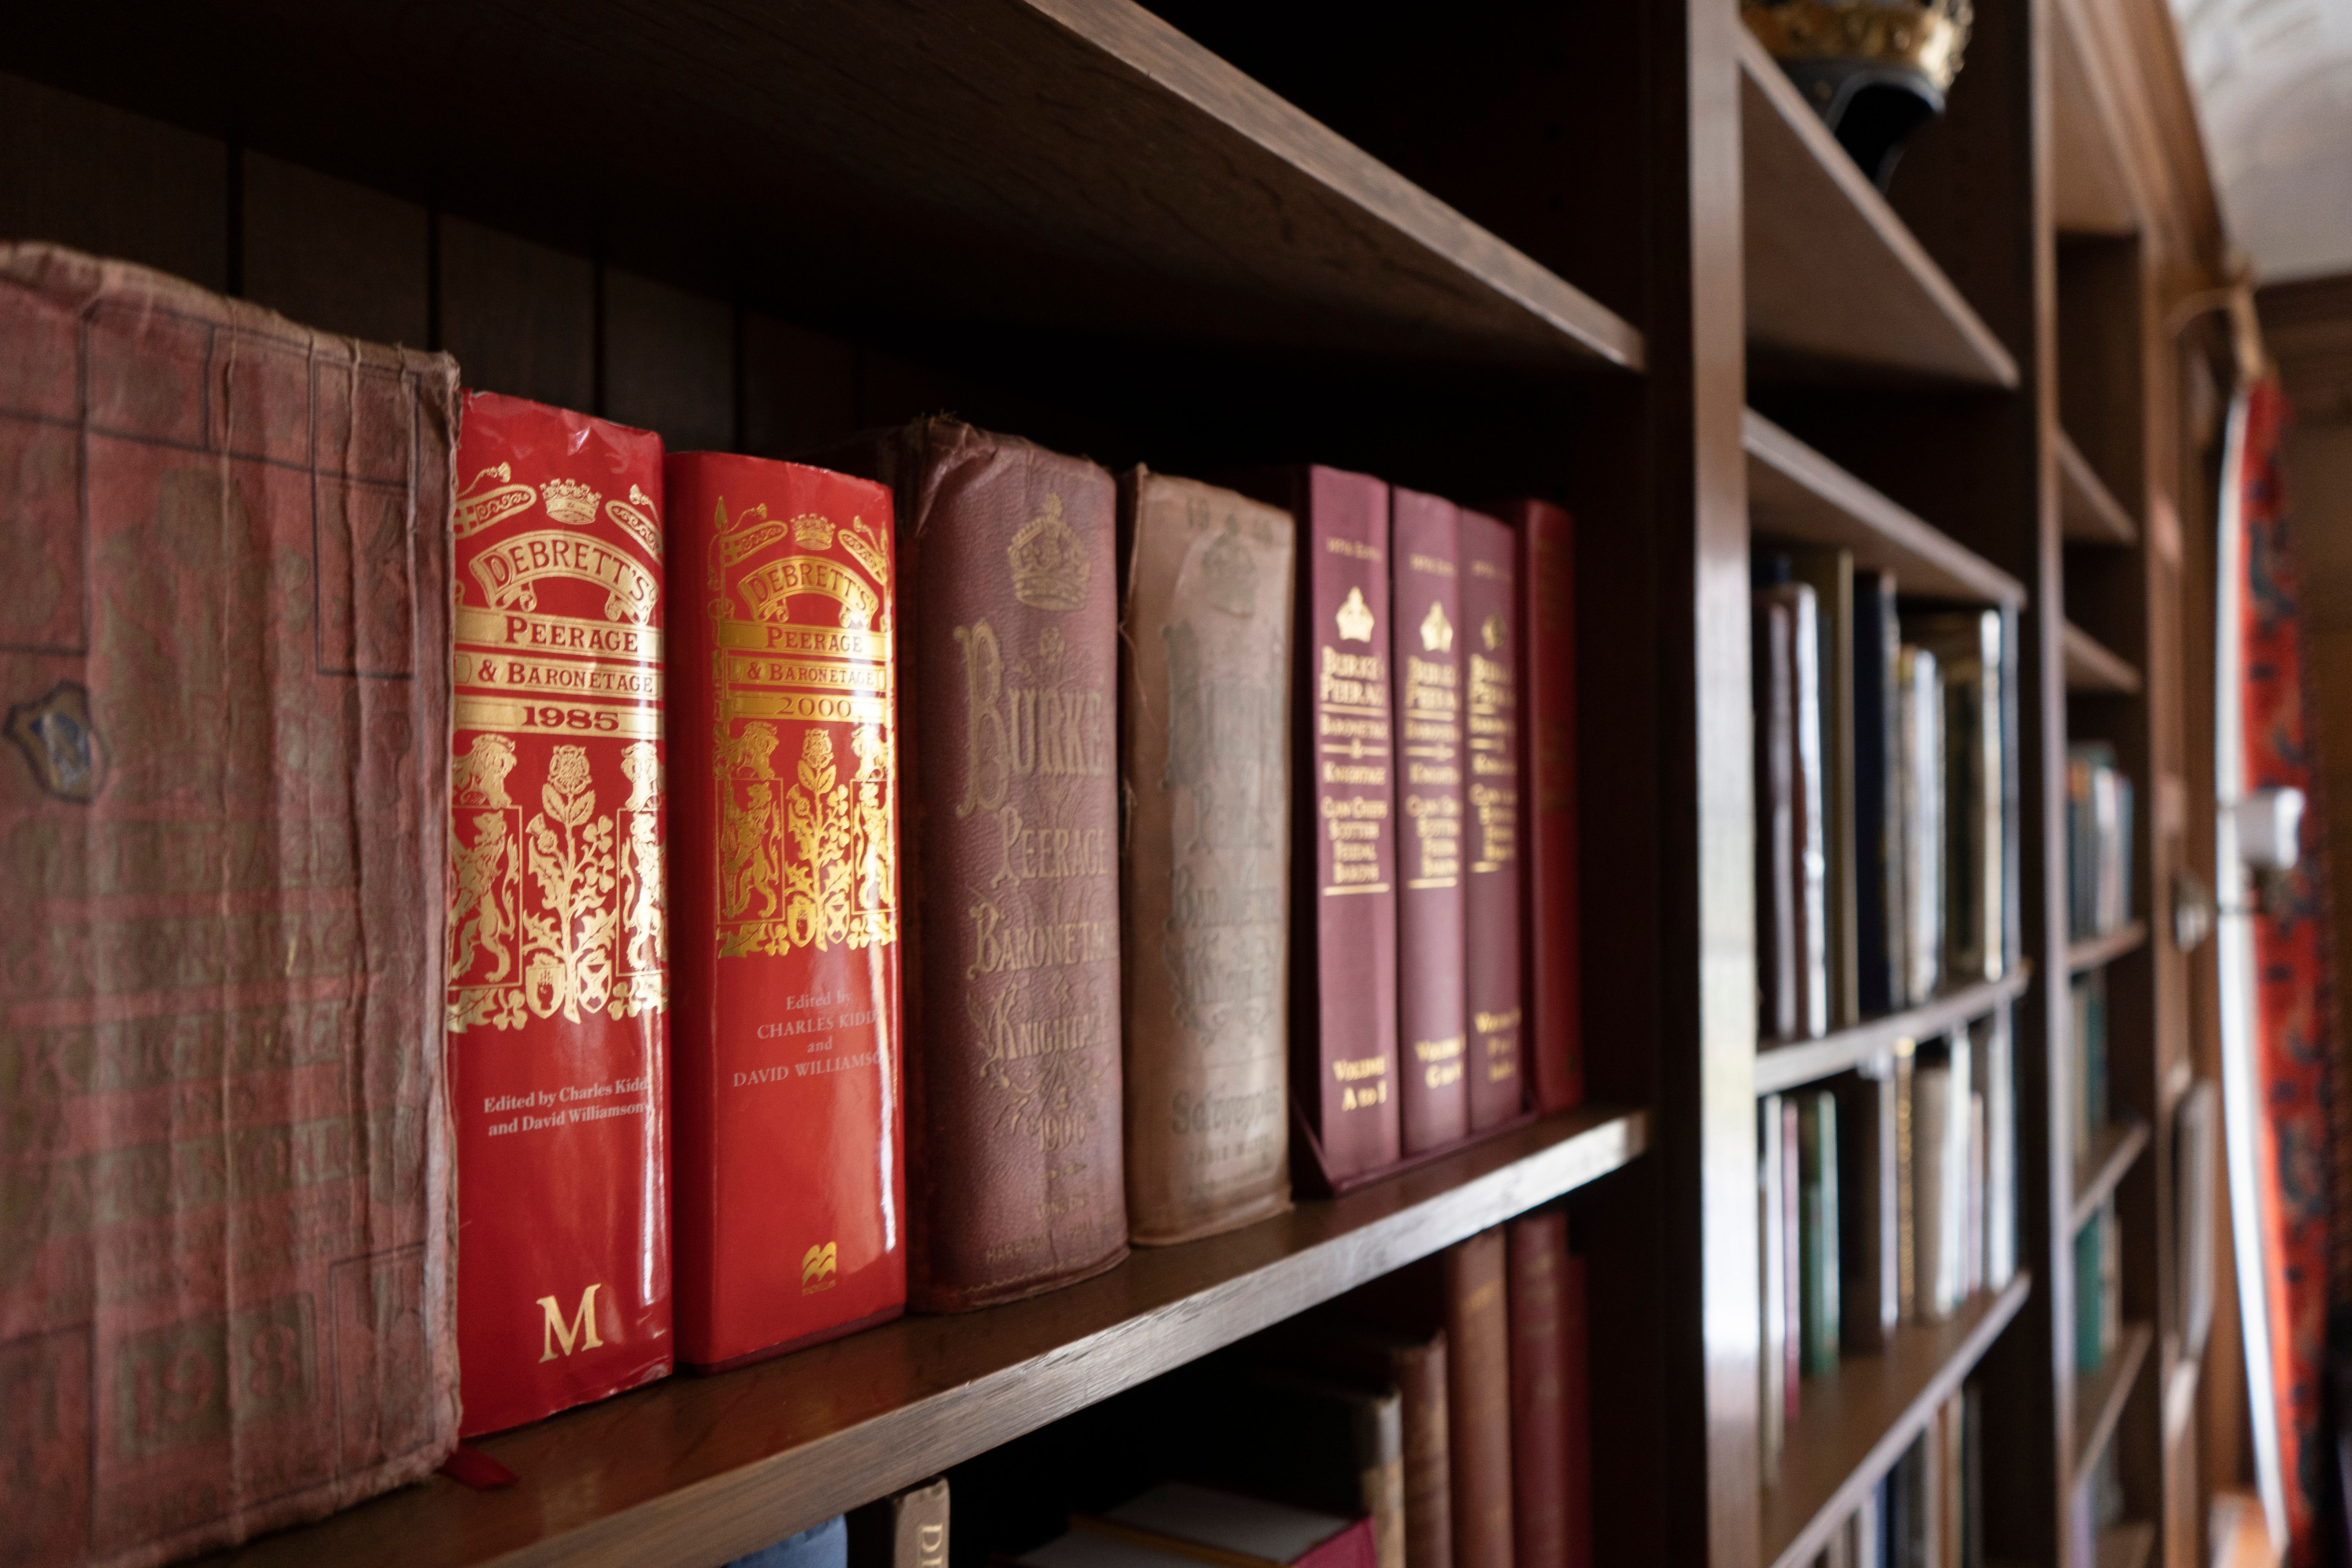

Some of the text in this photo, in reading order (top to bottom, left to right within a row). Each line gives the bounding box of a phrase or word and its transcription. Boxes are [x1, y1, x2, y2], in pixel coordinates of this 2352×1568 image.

[484, 539, 651, 601] DEBRETT'S
[748, 563, 872, 611] DEBRETT'S
[505, 616, 638, 653] PEERAGE
[766, 626, 862, 652] PEERAGE
[478, 659, 653, 693] & BARONETAGE
[747, 662, 874, 685] & BARONETAGE
[523, 706, 619, 731] 1985
[775, 697, 852, 718] 2000
[991, 805, 1109, 889] PEERAGE
[786, 990, 853, 1011] Edited by
[757, 1017, 834, 1040] CHARLES
[807, 1035, 833, 1053] and
[733, 1051, 885, 1087] DAVID WILLIAMSO
[483, 1076, 650, 1113] Edited by Charles Kidd
[488, 1102, 646, 1136] and David Williamson
[536, 1283, 604, 1364] M
